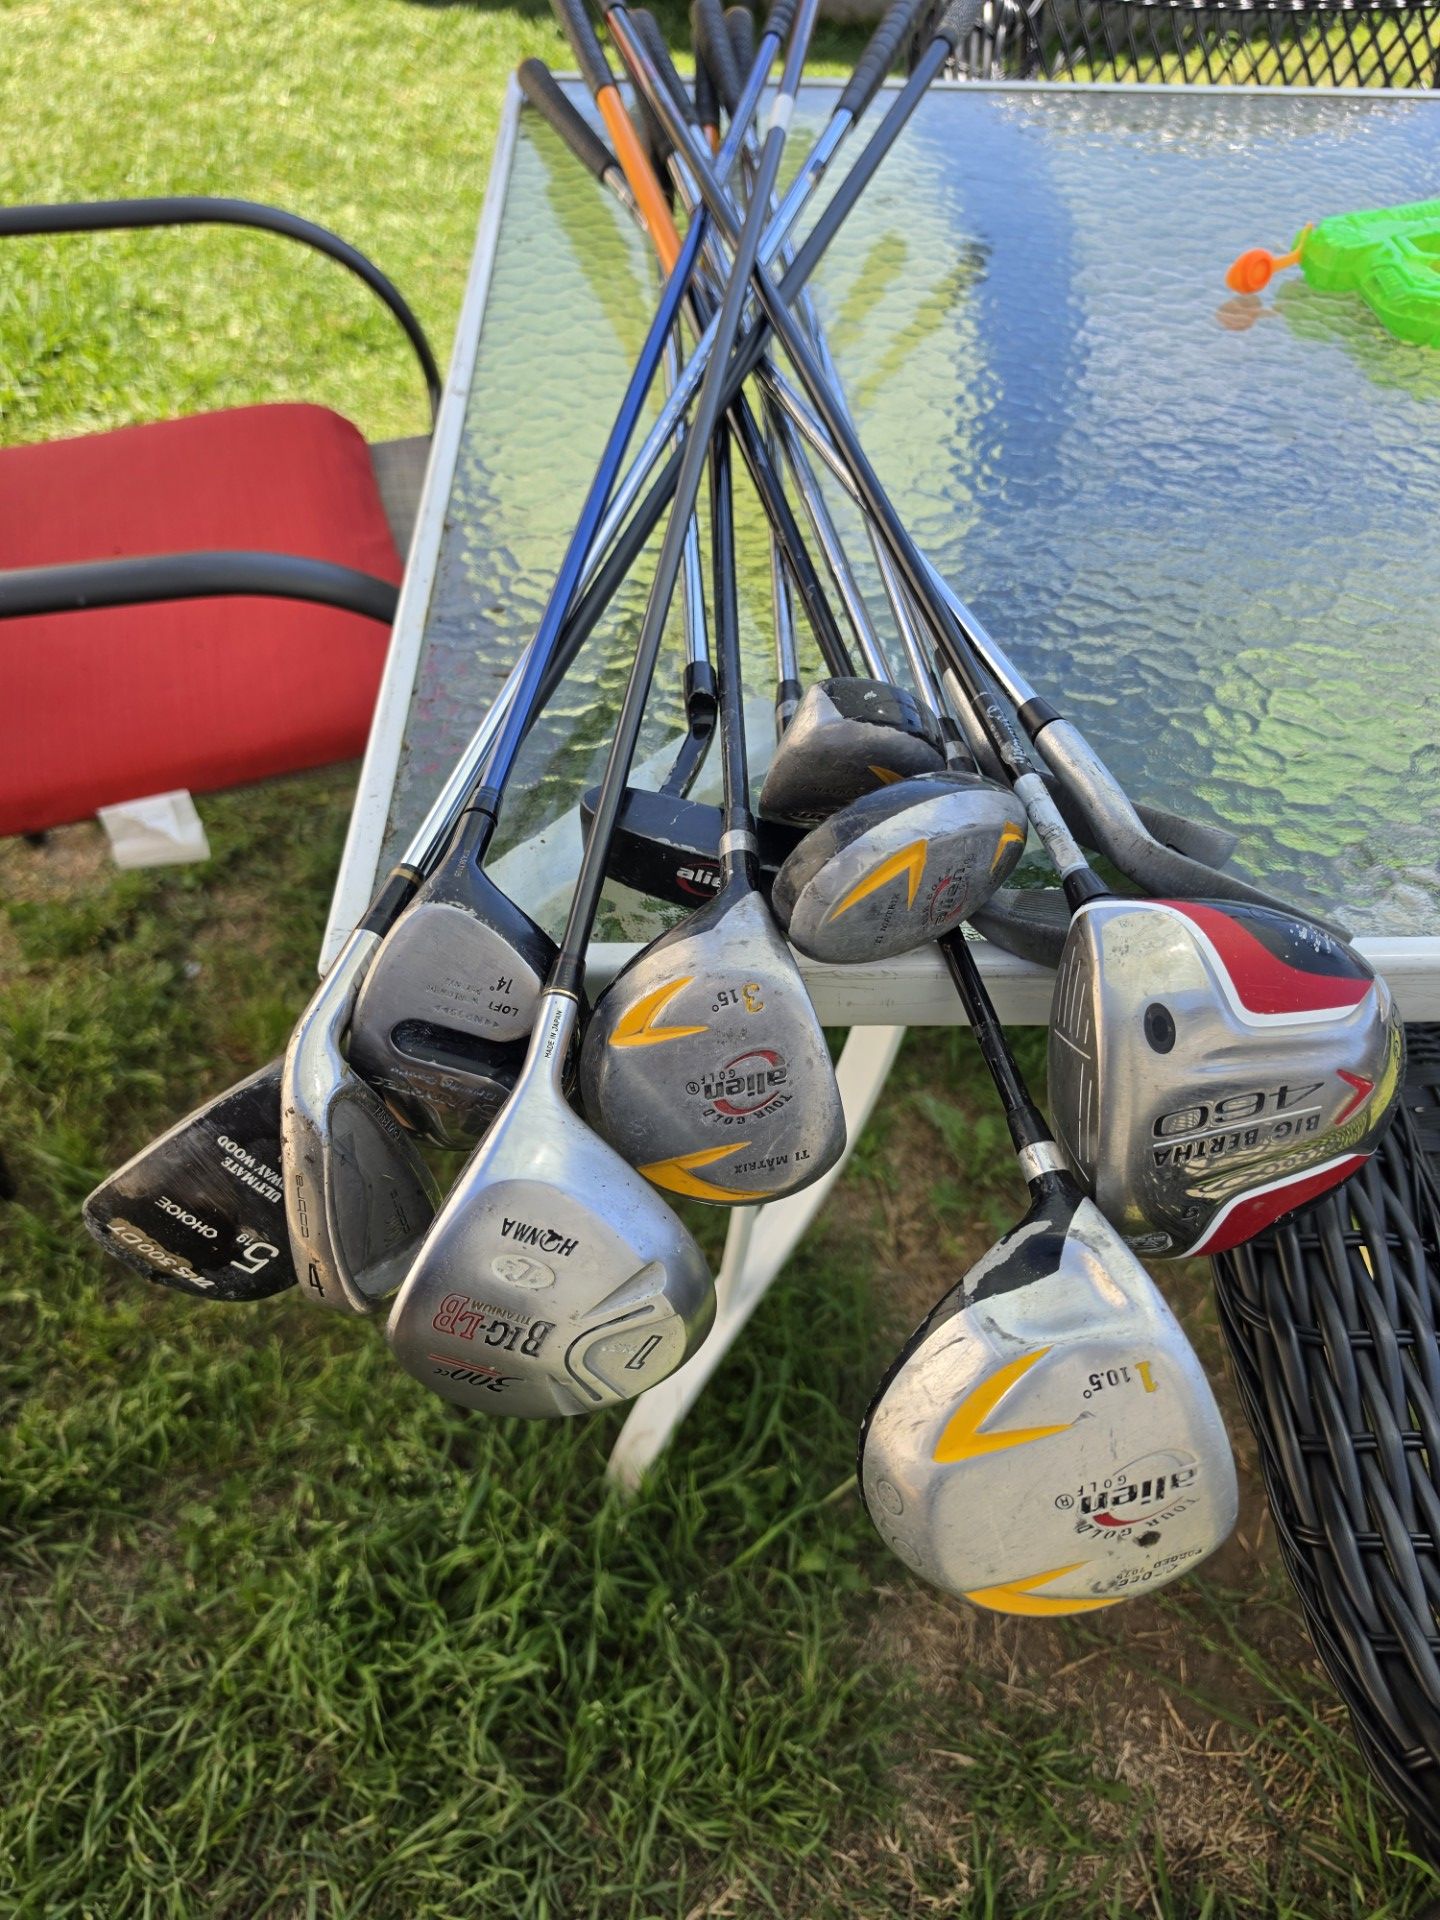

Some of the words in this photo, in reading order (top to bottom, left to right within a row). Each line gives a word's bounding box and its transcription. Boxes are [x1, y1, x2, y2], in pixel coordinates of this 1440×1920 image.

[677, 867, 720, 887] alie
[487, 1001, 519, 1017] LOFT
[742, 983, 764, 1014] 3
[551, 1010, 562, 1031] JAPAN
[544, 1040, 555, 1058] MADE
[549, 1031, 557, 1039] IN
[701, 1068, 736, 1085] GOLF
[704, 1066, 787, 1100] alien
[703, 1109, 746, 1125] GOLD
[755, 1094, 793, 1120] TOUR
[1152, 1082, 1325, 1137] 460
[1274, 1114, 1321, 1139] BIG
[216, 1135, 258, 1168] WOOD
[795, 1149, 810, 1162] TI
[1153, 1127, 1259, 1168] BERTHA
[253, 1163, 284, 1188] WAY
[734, 1154, 788, 1174] MATRIX
[221, 1156, 283, 1203] ULTIMATE
[154, 1195, 218, 1239] CHOICE
[295, 1174, 310, 1238] cobra
[235, 1233, 250, 1247] 19
[501, 1217, 579, 1256] HONMA
[230, 1241, 279, 1275] 5
[308, 1263, 326, 1298] 4
[471, 1300, 531, 1325] TITANIUM
[625, 1335, 663, 1369] 1
[1083, 1366, 1131, 1399] 10.5°
[1135, 1360, 1159, 1393] 1
[1077, 1475, 1127, 1497] GOLF
[1080, 1468, 1197, 1514] alien
[1147, 1497, 1200, 1527] TOUR
[1075, 1523, 1132, 1540] GOLD
